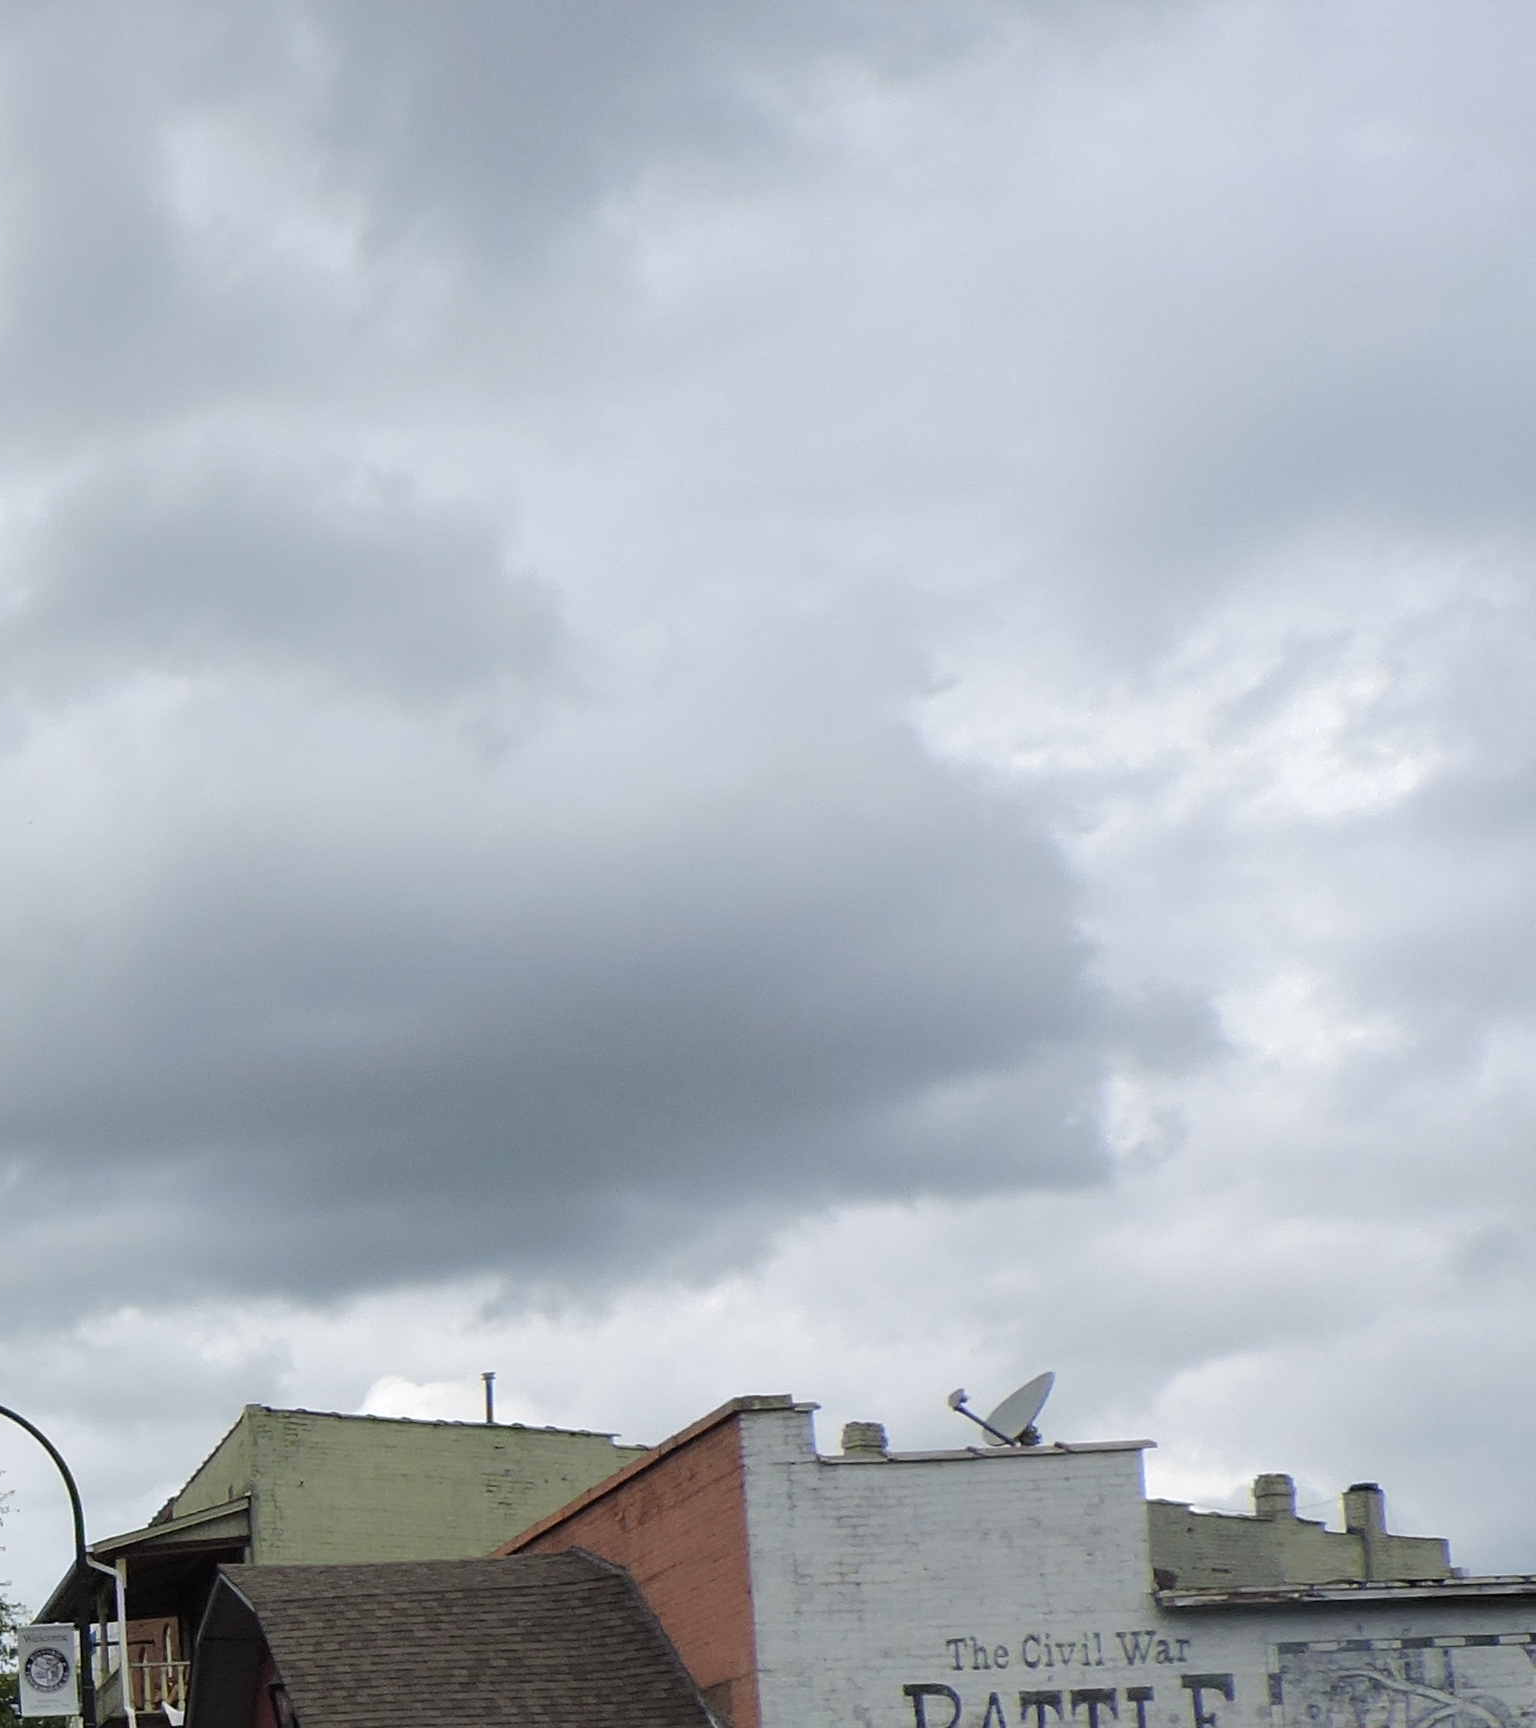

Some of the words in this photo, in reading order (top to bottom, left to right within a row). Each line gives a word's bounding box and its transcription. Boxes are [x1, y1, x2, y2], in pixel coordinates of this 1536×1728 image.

[946, 1636, 1010, 1670] The
[1022, 1632, 1104, 1668] Civil
[1116, 1630, 1191, 1665] War
